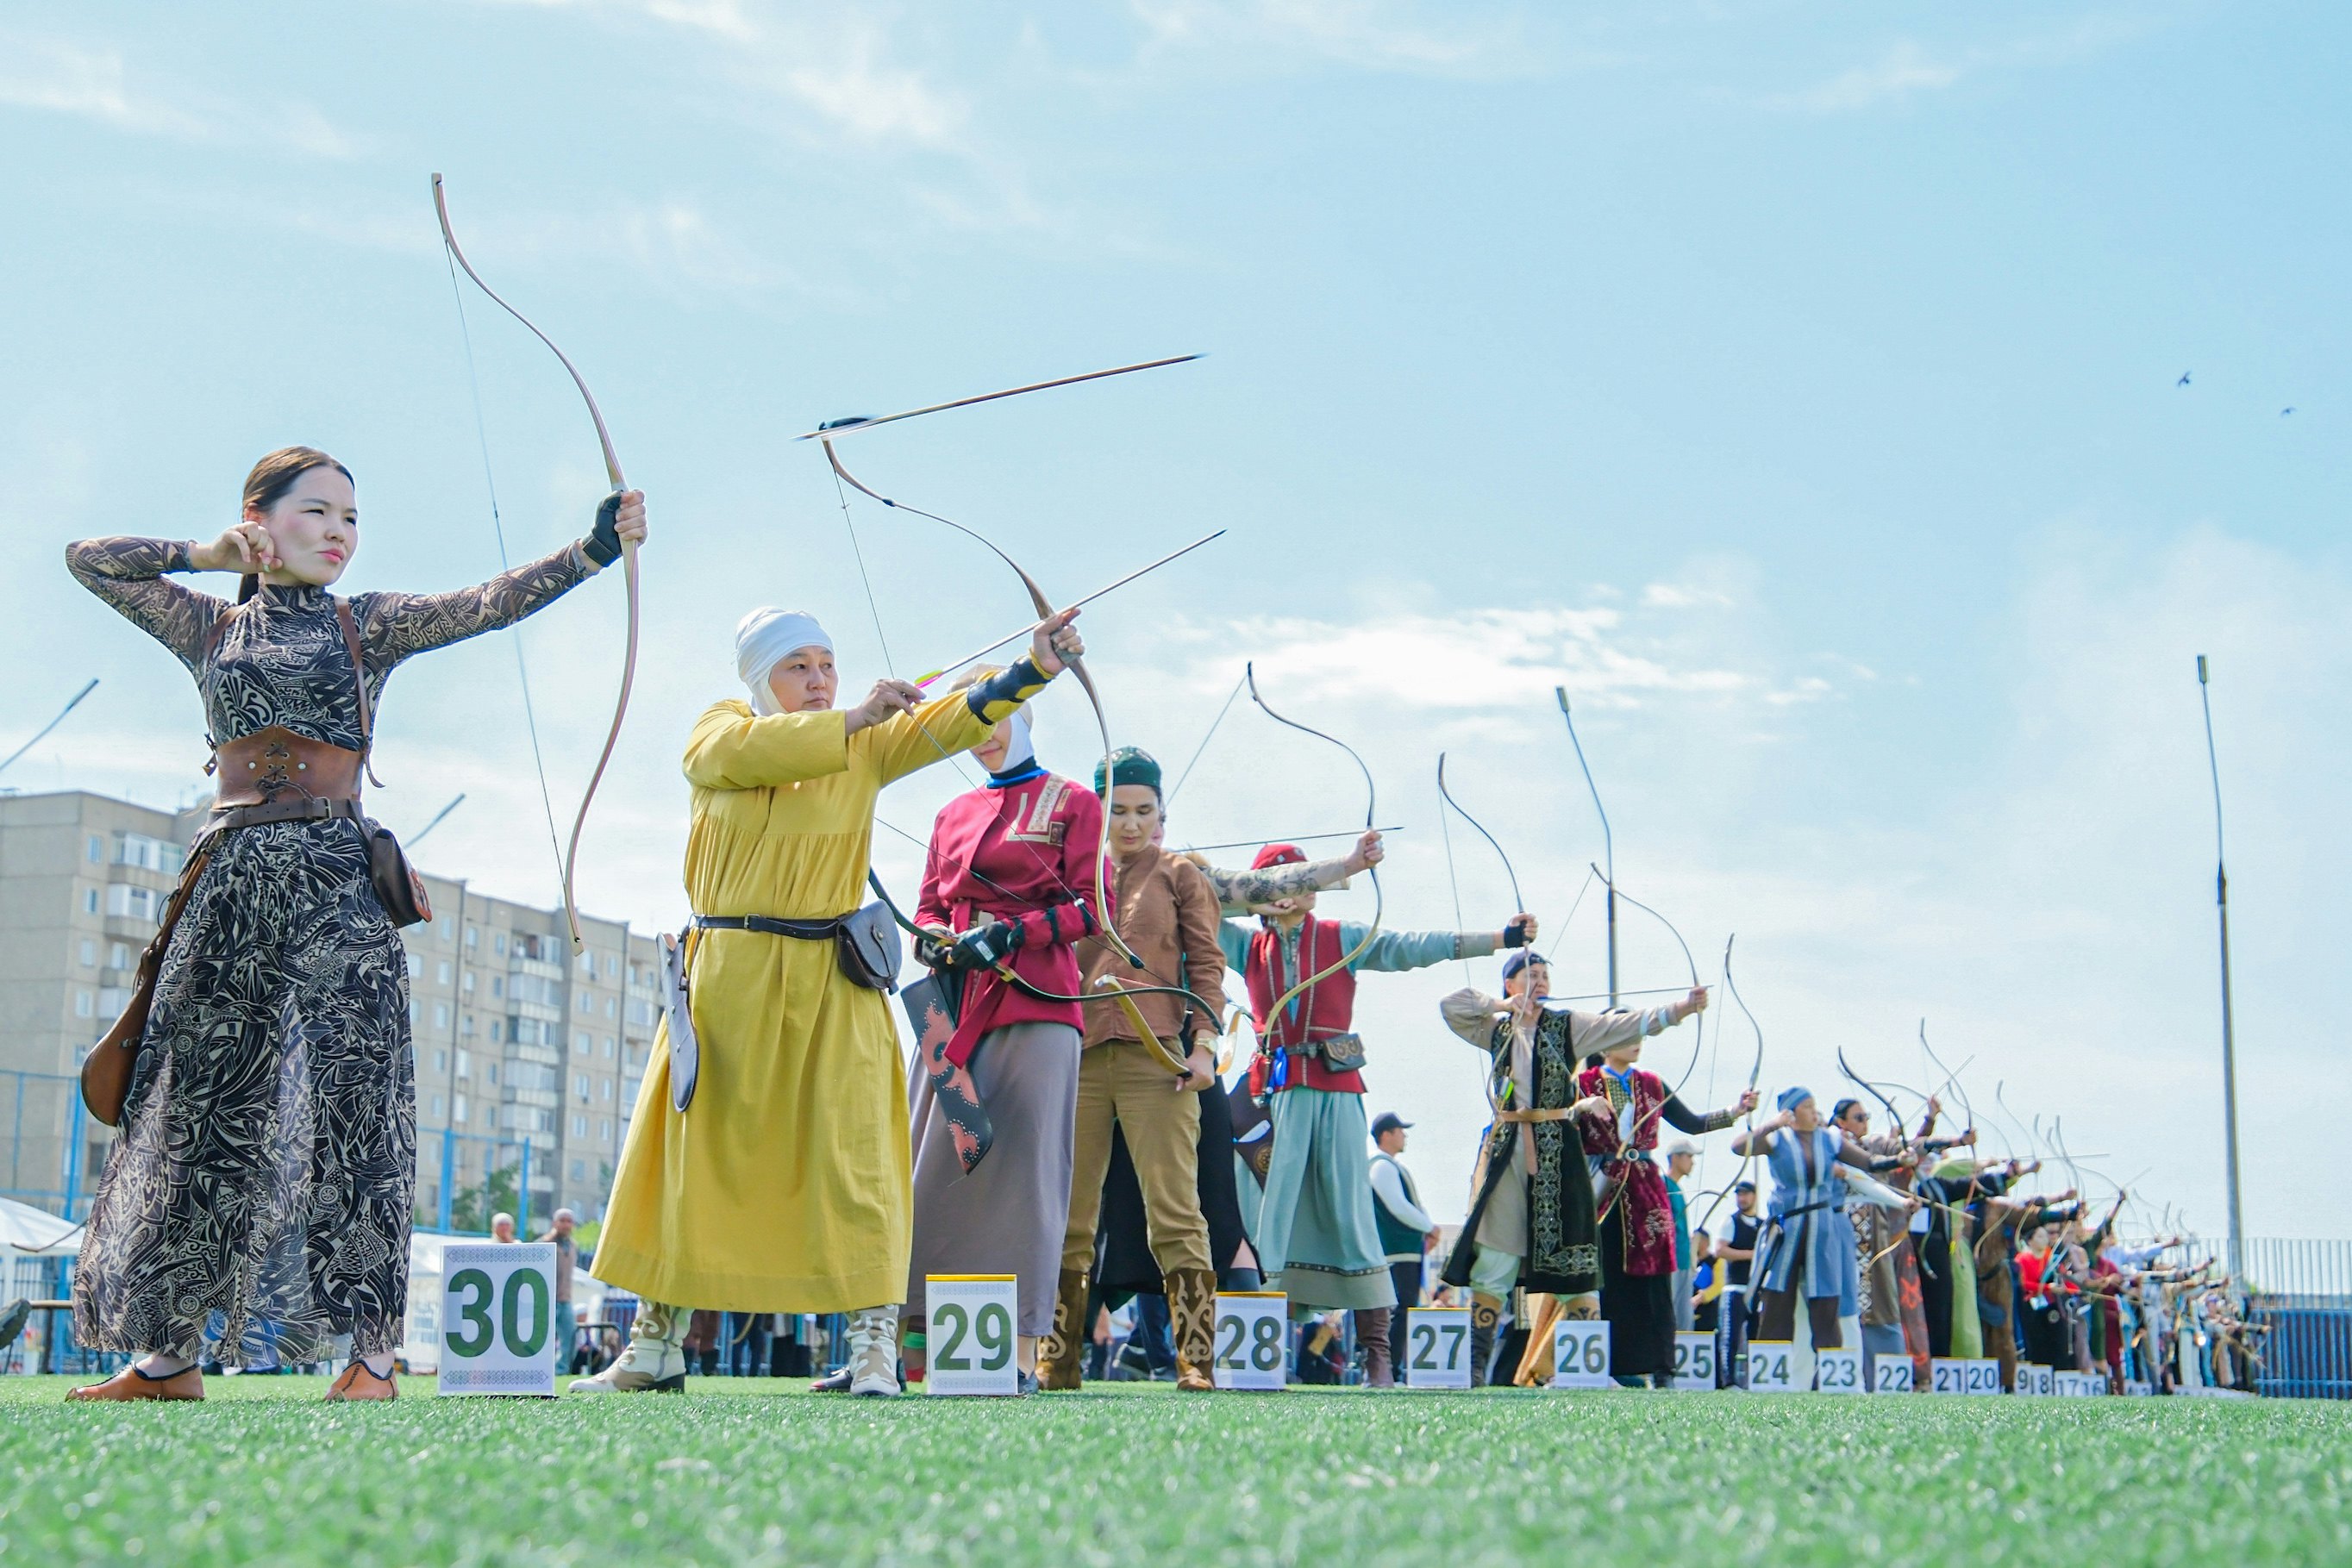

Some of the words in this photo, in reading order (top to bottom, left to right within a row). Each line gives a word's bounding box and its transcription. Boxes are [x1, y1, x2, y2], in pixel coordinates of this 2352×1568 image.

[446, 1267, 550, 1359] 30
[932, 1303, 1013, 1371] 29
[1216, 1315, 1282, 1371] 28
[1411, 1324, 1467, 1371] 27
[1557, 1334, 1605, 1373] 26
[1675, 1344, 1711, 1378] 25
[1752, 1354, 1790, 1385] 24
[1822, 1359, 1856, 1386] 23
[1879, 1365, 1910, 1391] 22
[1936, 1367, 1961, 1391] 21
[1969, 1367, 1996, 1390] 20
[2017, 1370, 2028, 1390] 9
[2058, 1379, 2079, 1396] 17
